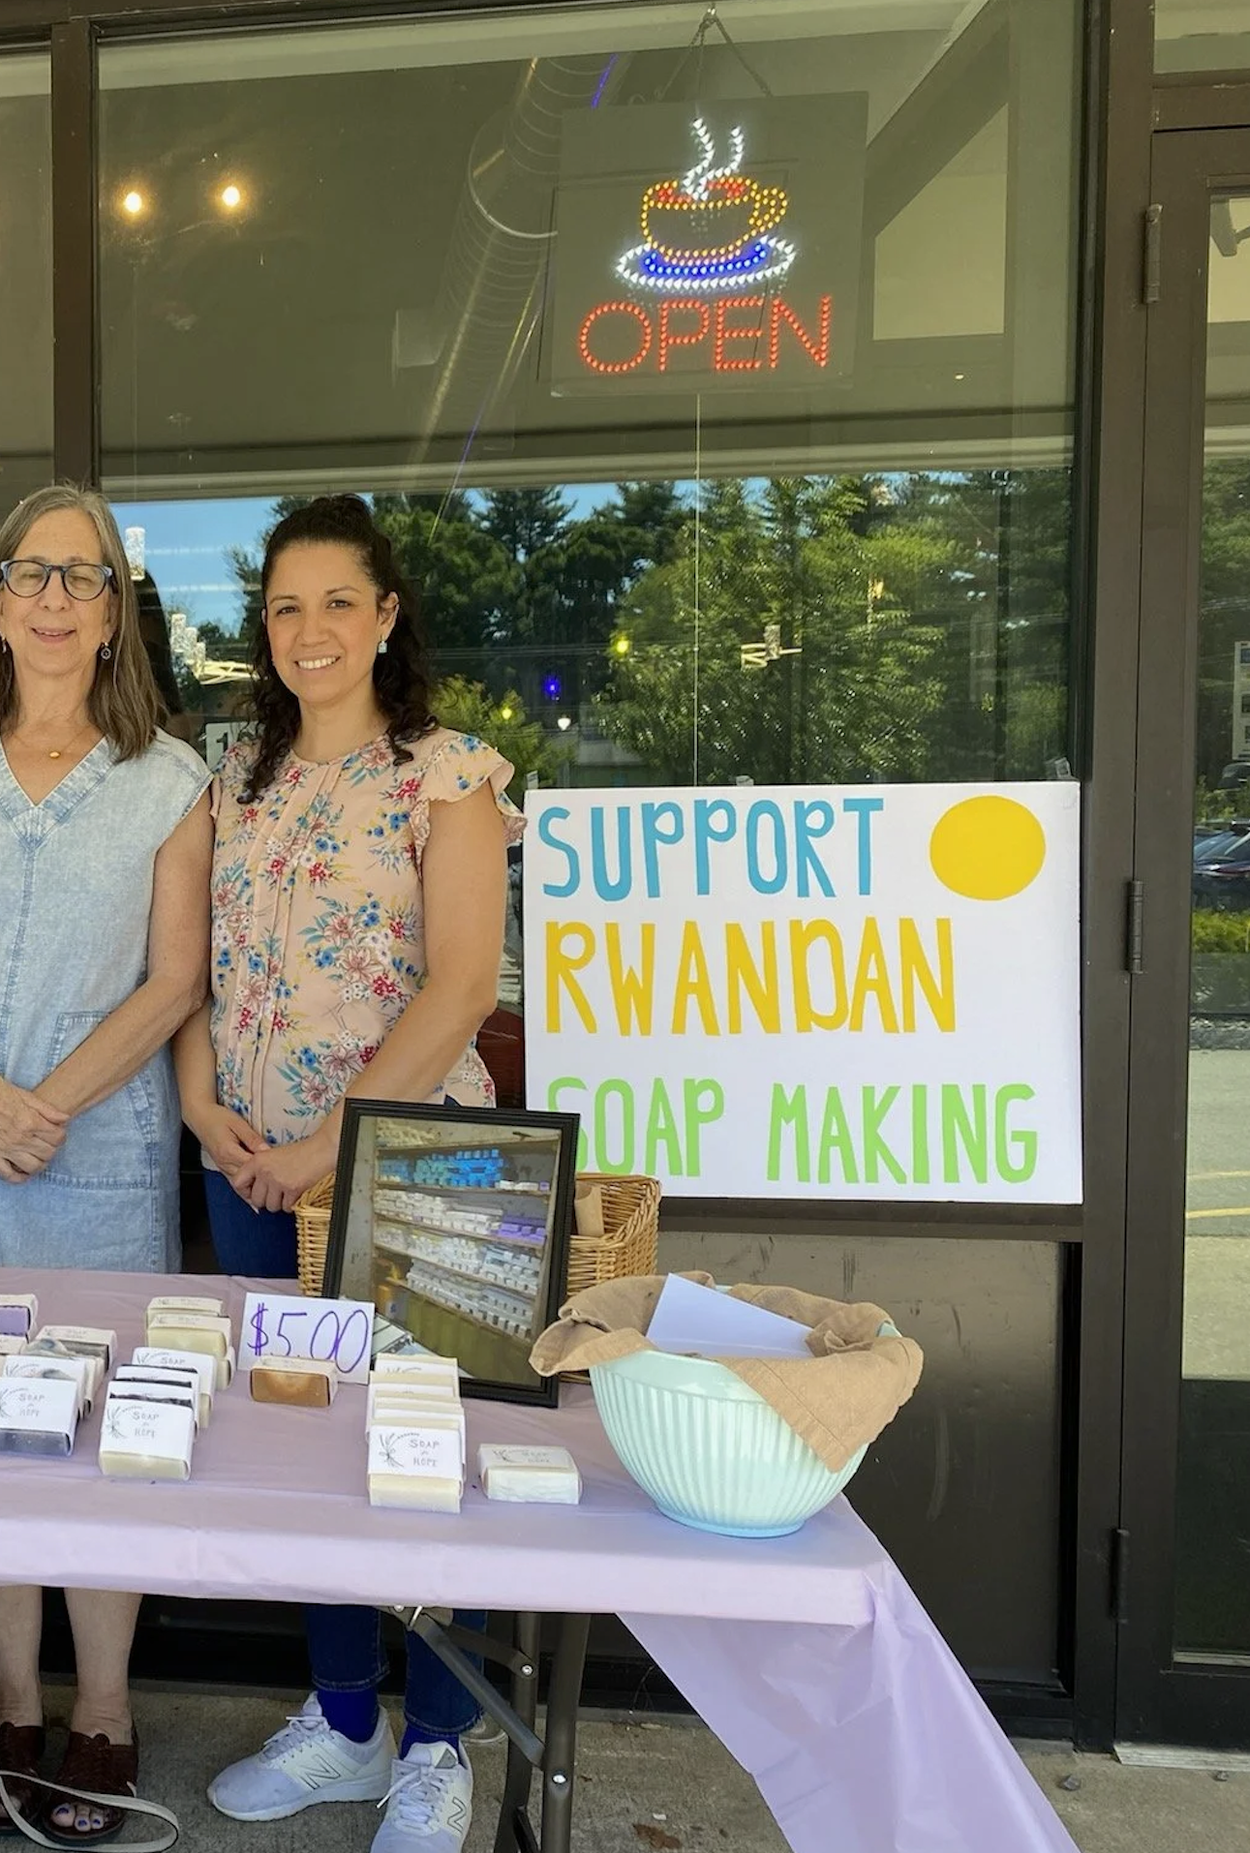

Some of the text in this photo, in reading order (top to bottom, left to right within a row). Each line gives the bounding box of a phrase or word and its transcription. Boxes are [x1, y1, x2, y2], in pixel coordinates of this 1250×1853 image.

[578, 294, 833, 373] OPEN
[538, 798, 884, 902] SUPPORT
[545, 916, 956, 1036] RWANDAN
[547, 1077, 1038, 1185] SOAP MAKING
[247, 1302, 369, 1374] $5.00
